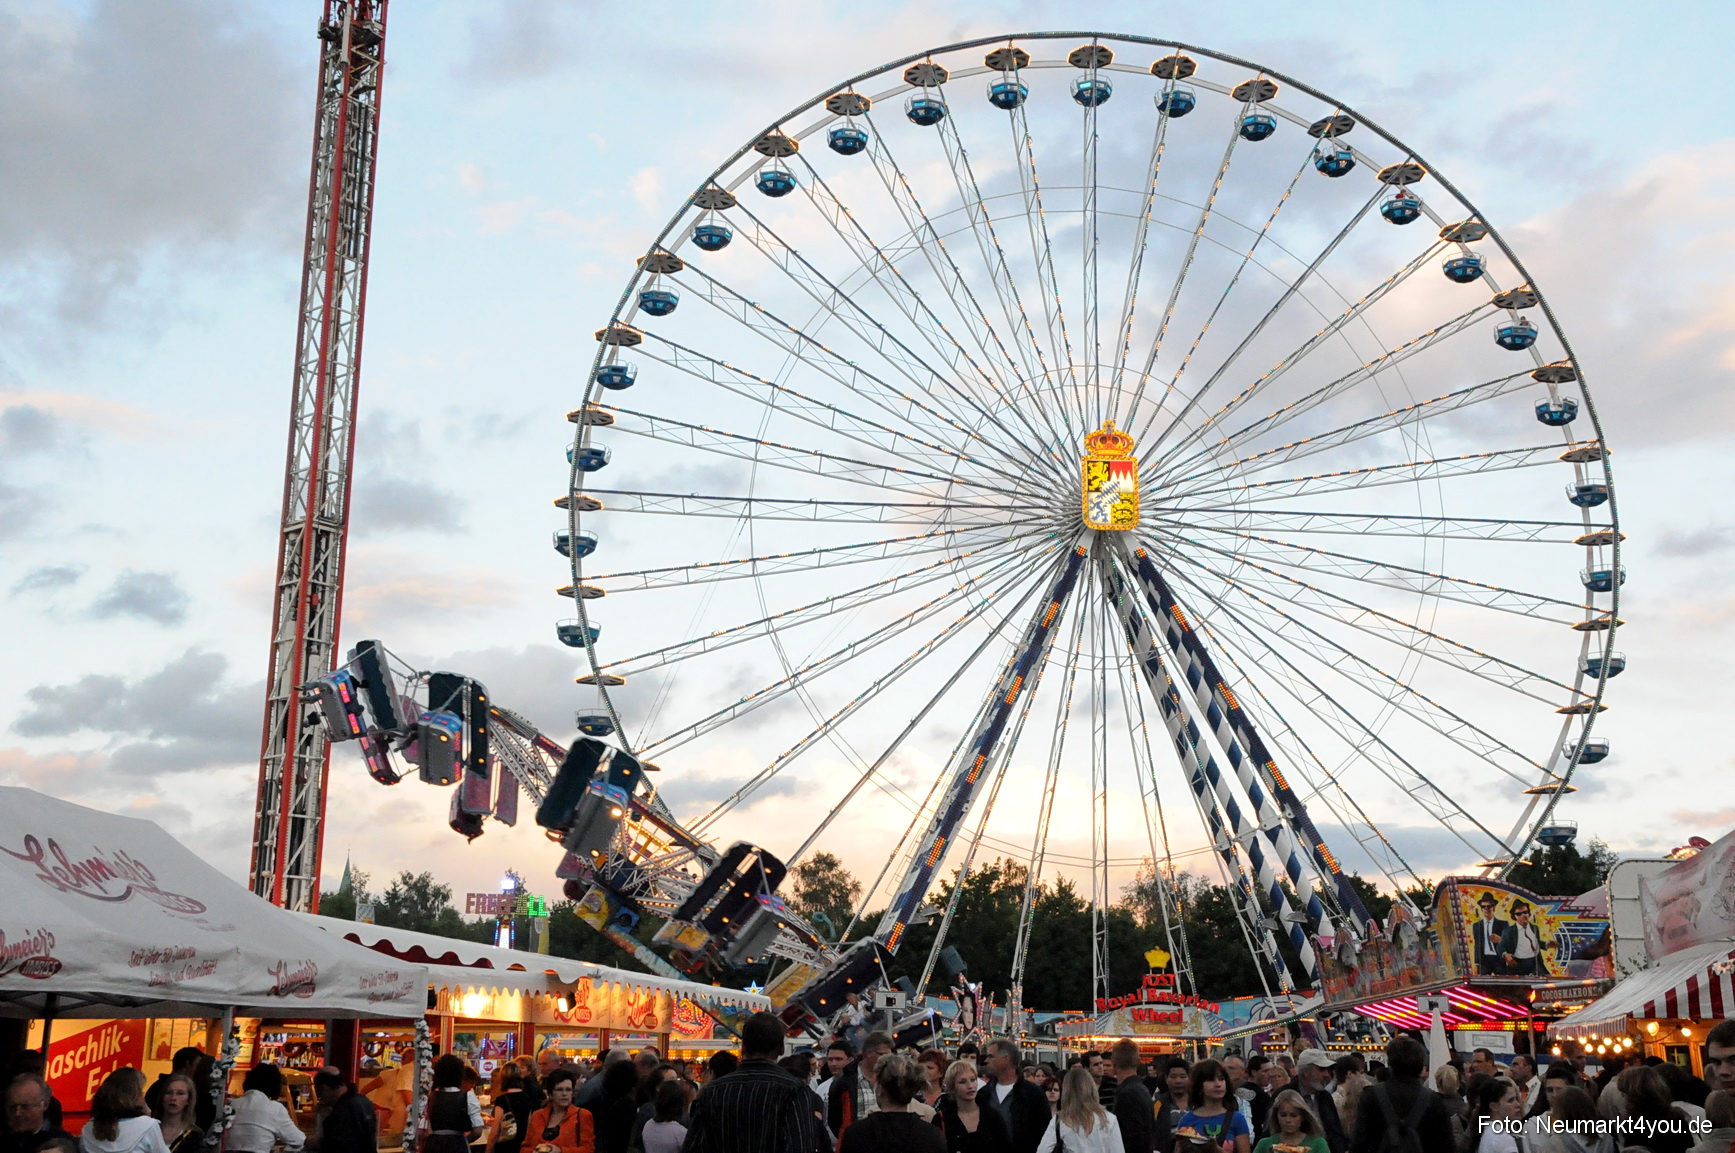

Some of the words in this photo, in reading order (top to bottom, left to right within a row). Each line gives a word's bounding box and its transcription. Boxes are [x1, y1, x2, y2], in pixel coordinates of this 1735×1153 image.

[22, 960, 59, 976] IMBISS
[1143, 973, 1176, 989] JOST
[1096, 988, 1144, 1012] Royal
[1147, 987, 1221, 1014] Bavarian
[1131, 1007, 1184, 1023] Wheel
[45, 1024, 130, 1081] aschlik-
